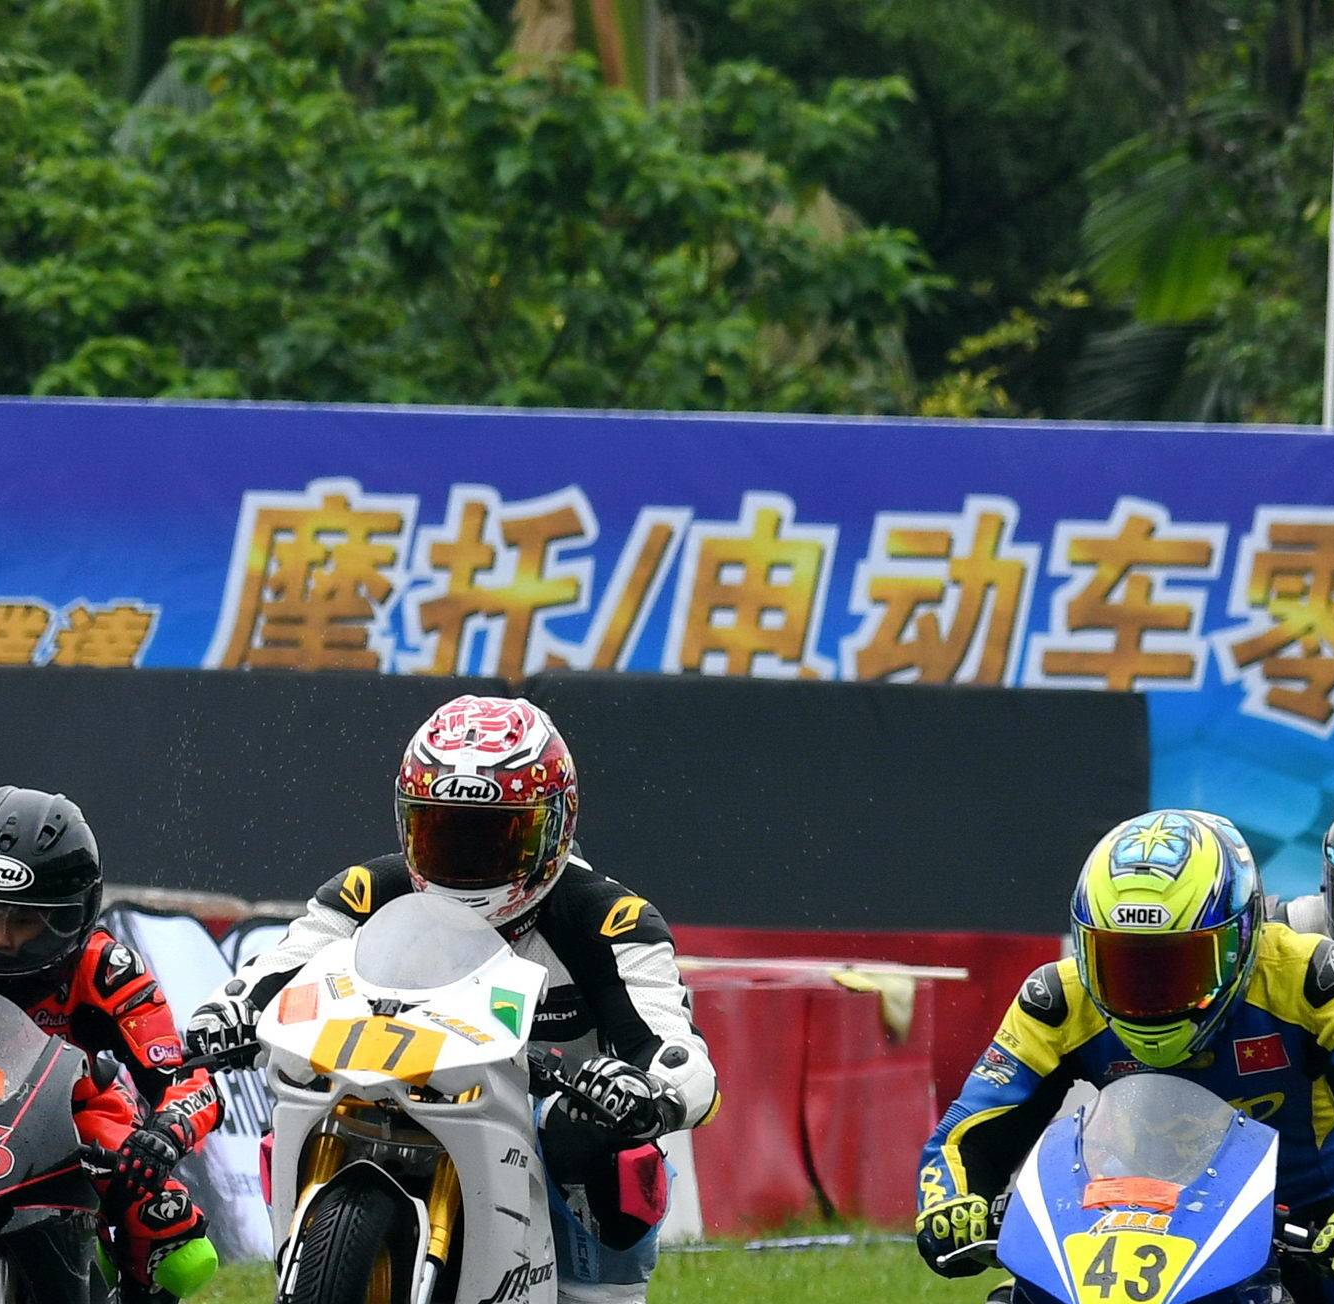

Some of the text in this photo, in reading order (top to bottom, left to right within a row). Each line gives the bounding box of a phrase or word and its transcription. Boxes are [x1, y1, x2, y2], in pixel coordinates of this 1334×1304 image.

[436, 778, 493, 798] Arai
[1117, 908, 1162, 924] SHOEI
[334, 1020, 416, 1071] 17
[1082, 1236, 1167, 1302] 43
